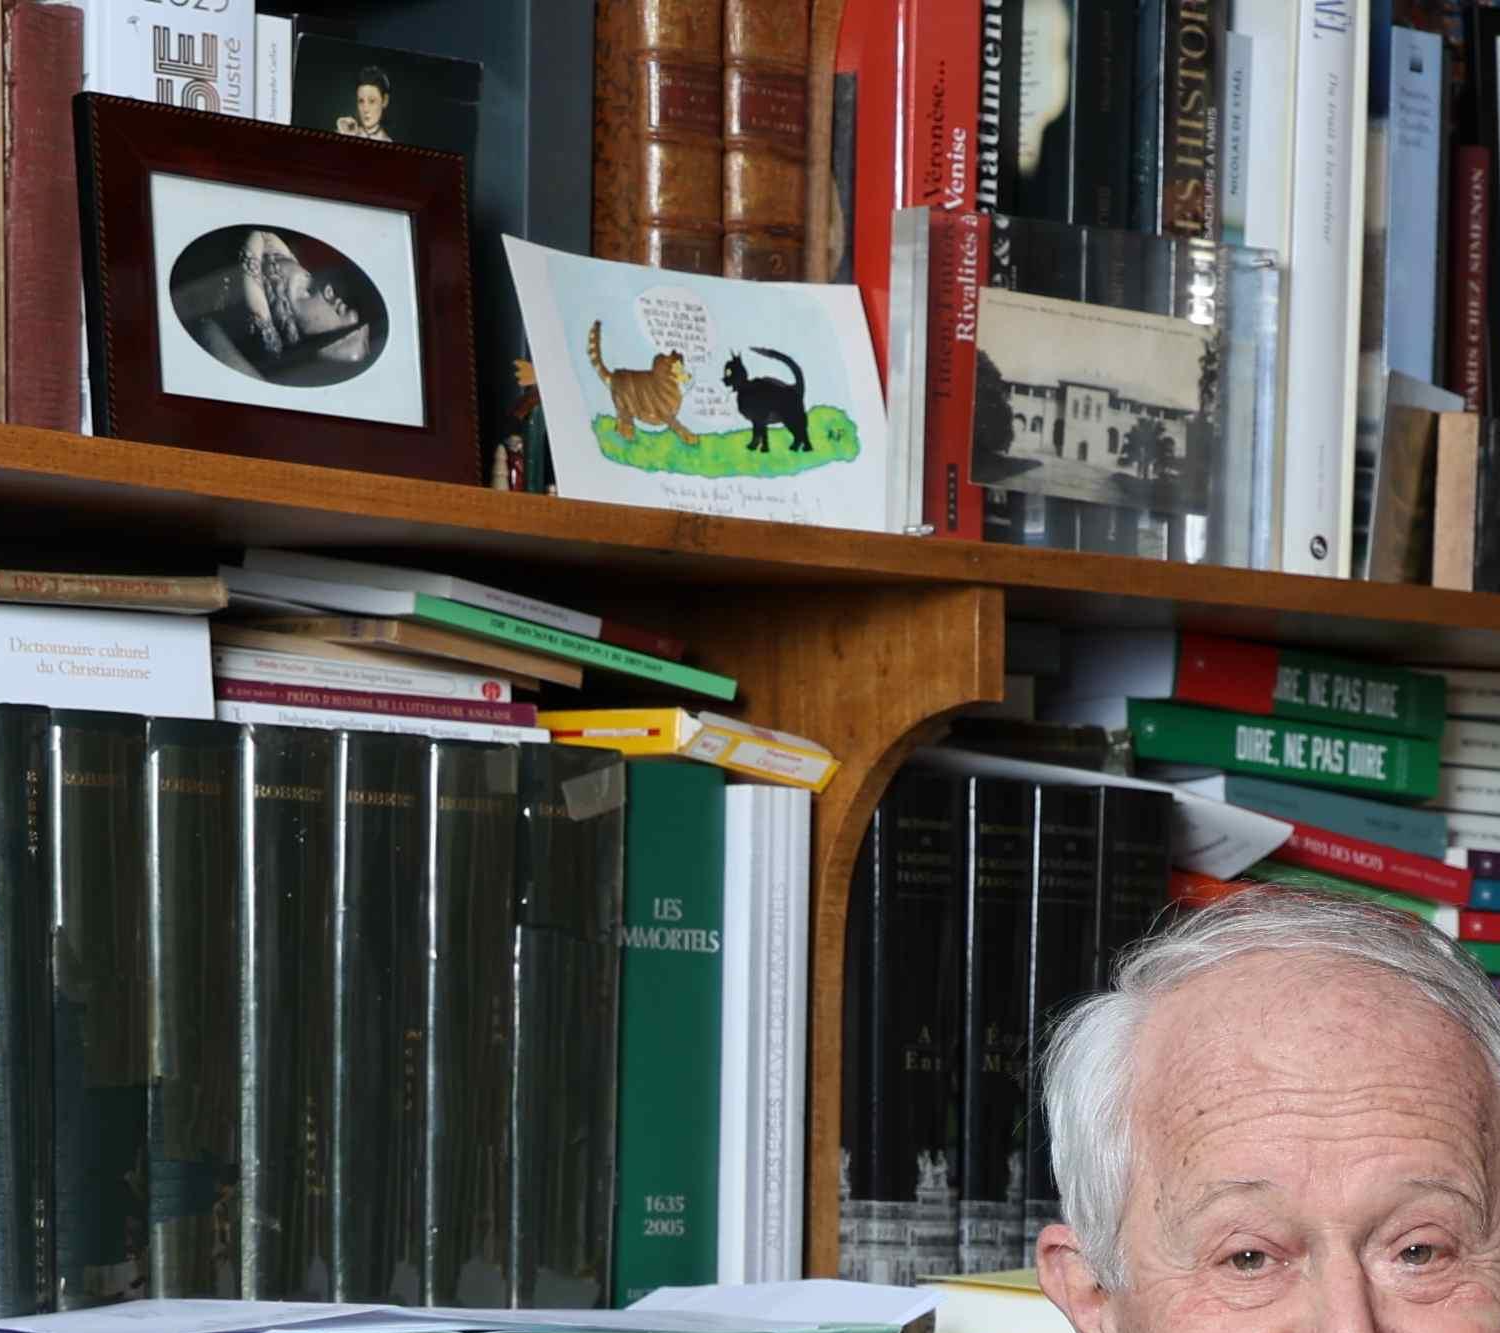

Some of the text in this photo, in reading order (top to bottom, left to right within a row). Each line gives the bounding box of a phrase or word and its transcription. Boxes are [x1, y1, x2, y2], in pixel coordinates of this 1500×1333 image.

[1205, 106, 1218, 151] PARIS
[1229, 112, 1243, 198] NICOLAS DE
[944, 127, 978, 344] Rivalités Venise
[1467, 166, 1485, 273] SIMENON
[1463, 345, 1482, 411] PARIS
[9, 636, 150, 659] Dictionnaire culturel
[35, 658, 152, 680] du Christianisme
[1308, 670, 1400, 719] NE PAS DIRE
[1234, 726, 1388, 781] DIRE, NE PAS DIRE
[253, 782, 324, 803] ROBERT
[652, 896, 683, 921] LES
[644, 1194, 685, 1213] 1635
[644, 1217, 685, 1236] 2005
